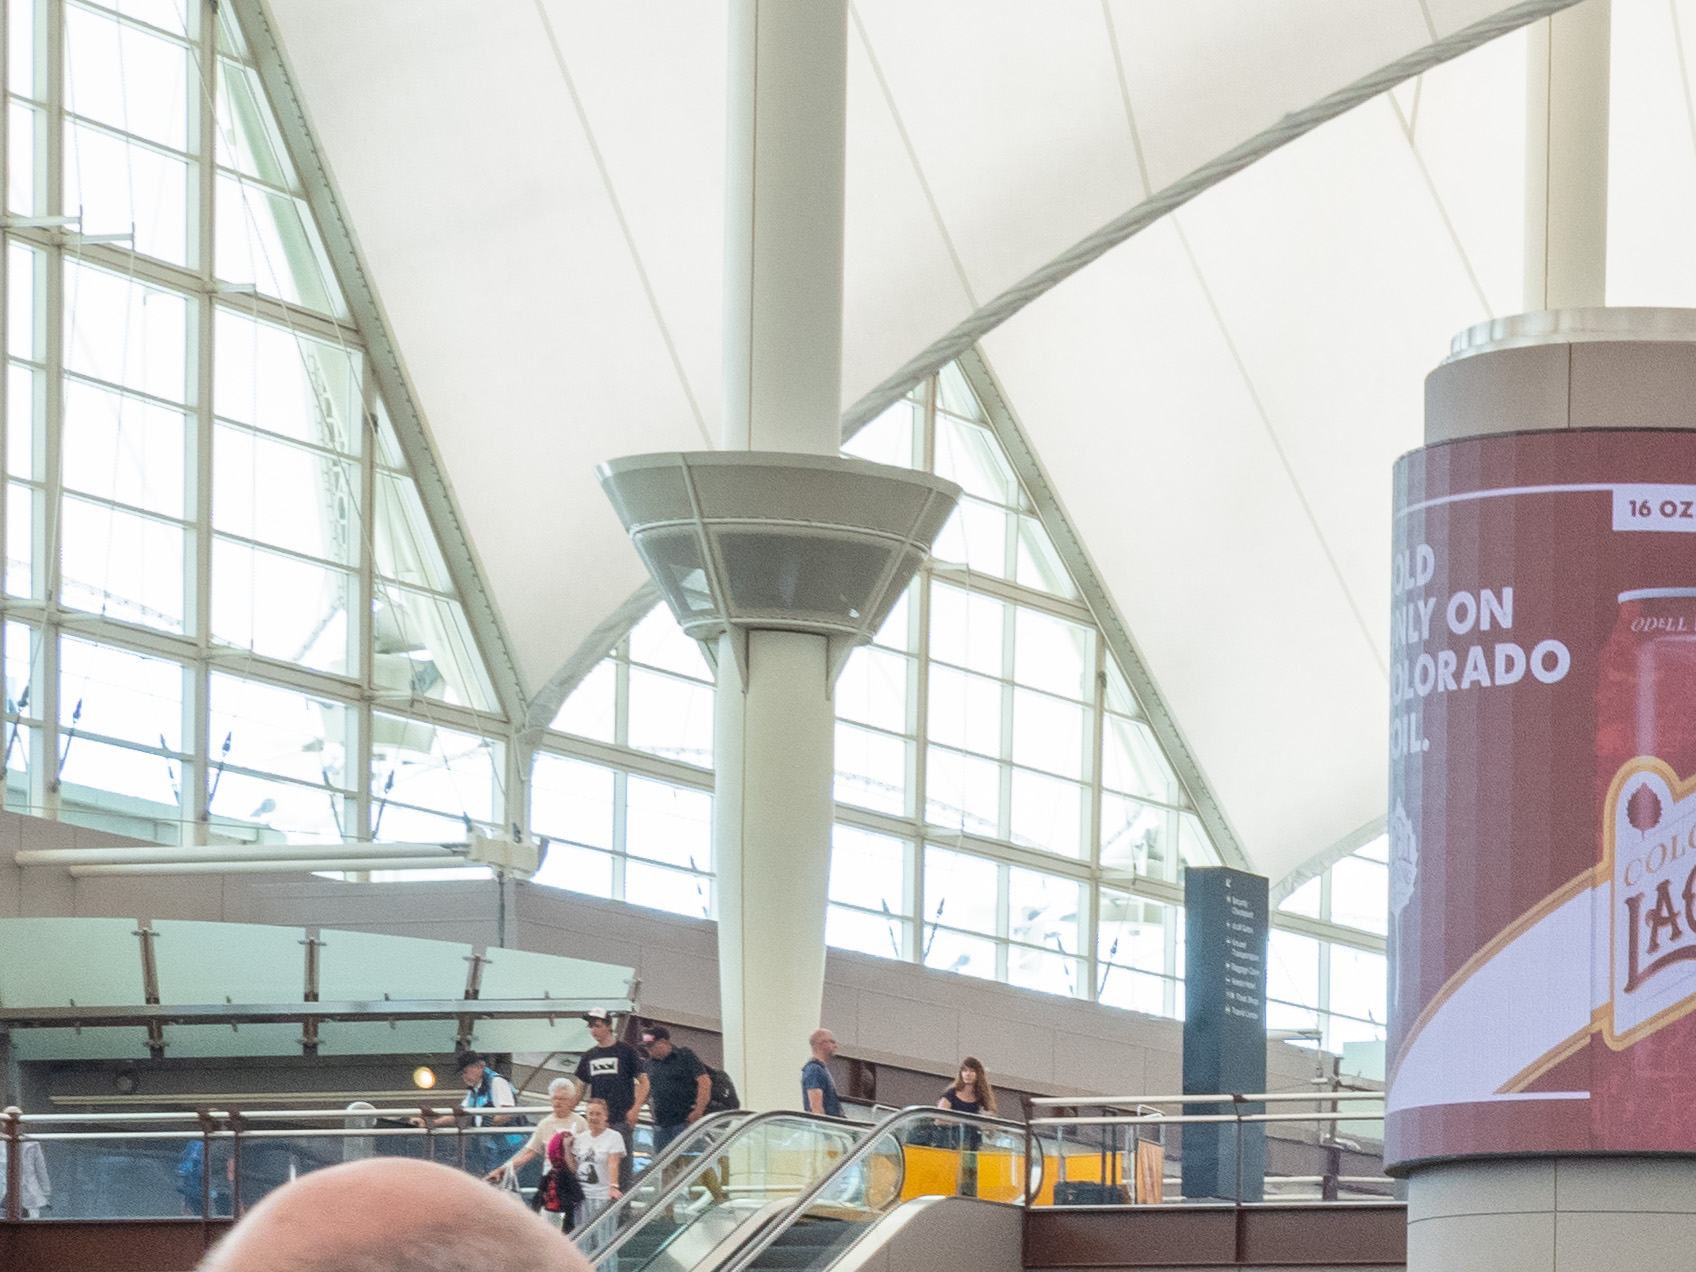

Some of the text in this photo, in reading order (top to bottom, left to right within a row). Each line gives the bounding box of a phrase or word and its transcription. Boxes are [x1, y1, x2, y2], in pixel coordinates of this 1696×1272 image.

[1629, 500, 1652, 518] 16
[1394, 543, 1436, 597] OLD
[1396, 586, 1514, 646] NLY ON
[1630, 616, 1688, 632] ODELL
[1393, 639, 1571, 706] OLORADO
[1391, 711, 1431, 761] OIL.
